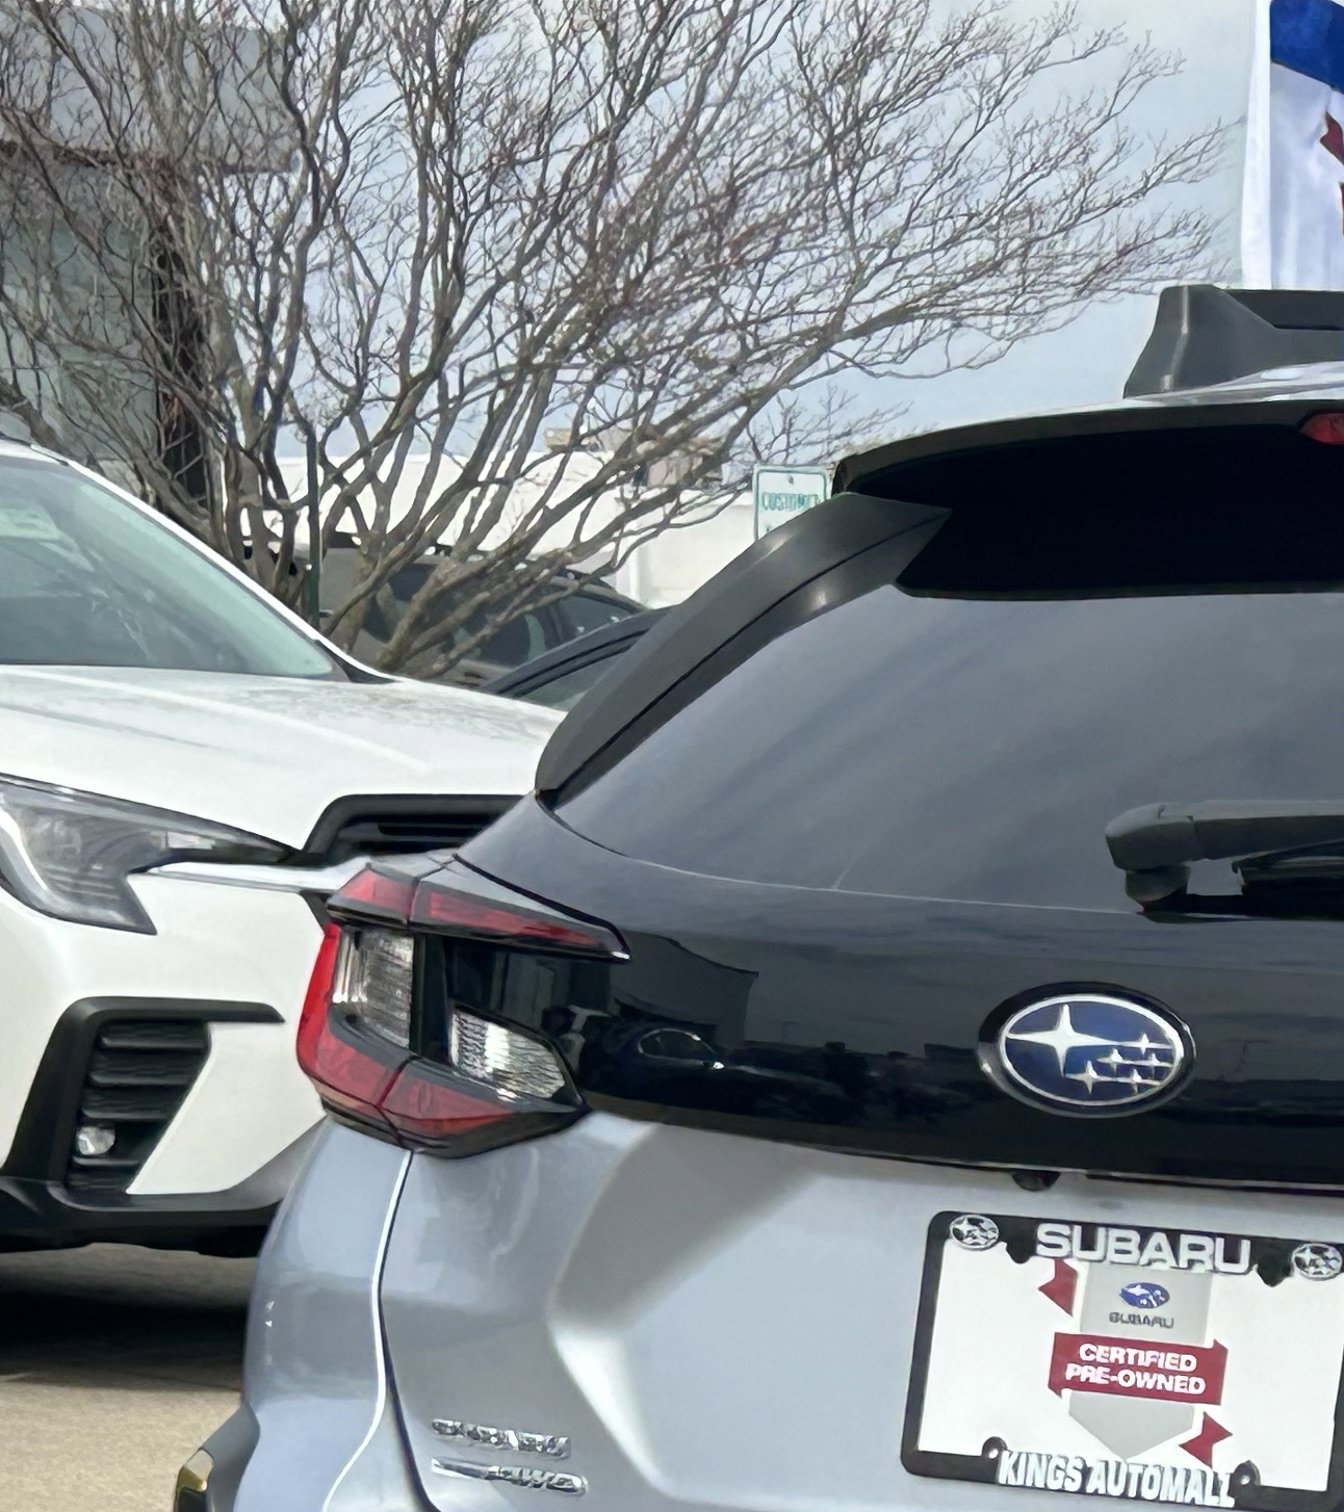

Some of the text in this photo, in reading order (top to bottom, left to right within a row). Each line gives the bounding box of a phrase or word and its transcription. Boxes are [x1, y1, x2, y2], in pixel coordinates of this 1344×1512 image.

[1036, 1223, 1252, 1274] SUBARU
[1108, 1312, 1175, 1329] SUBARU
[1079, 1343, 1197, 1373] CERTIFIED
[1065, 1363, 1206, 1395] PRE-OWNED
[999, 1450, 1236, 1508] KINGS AUTOMALL
